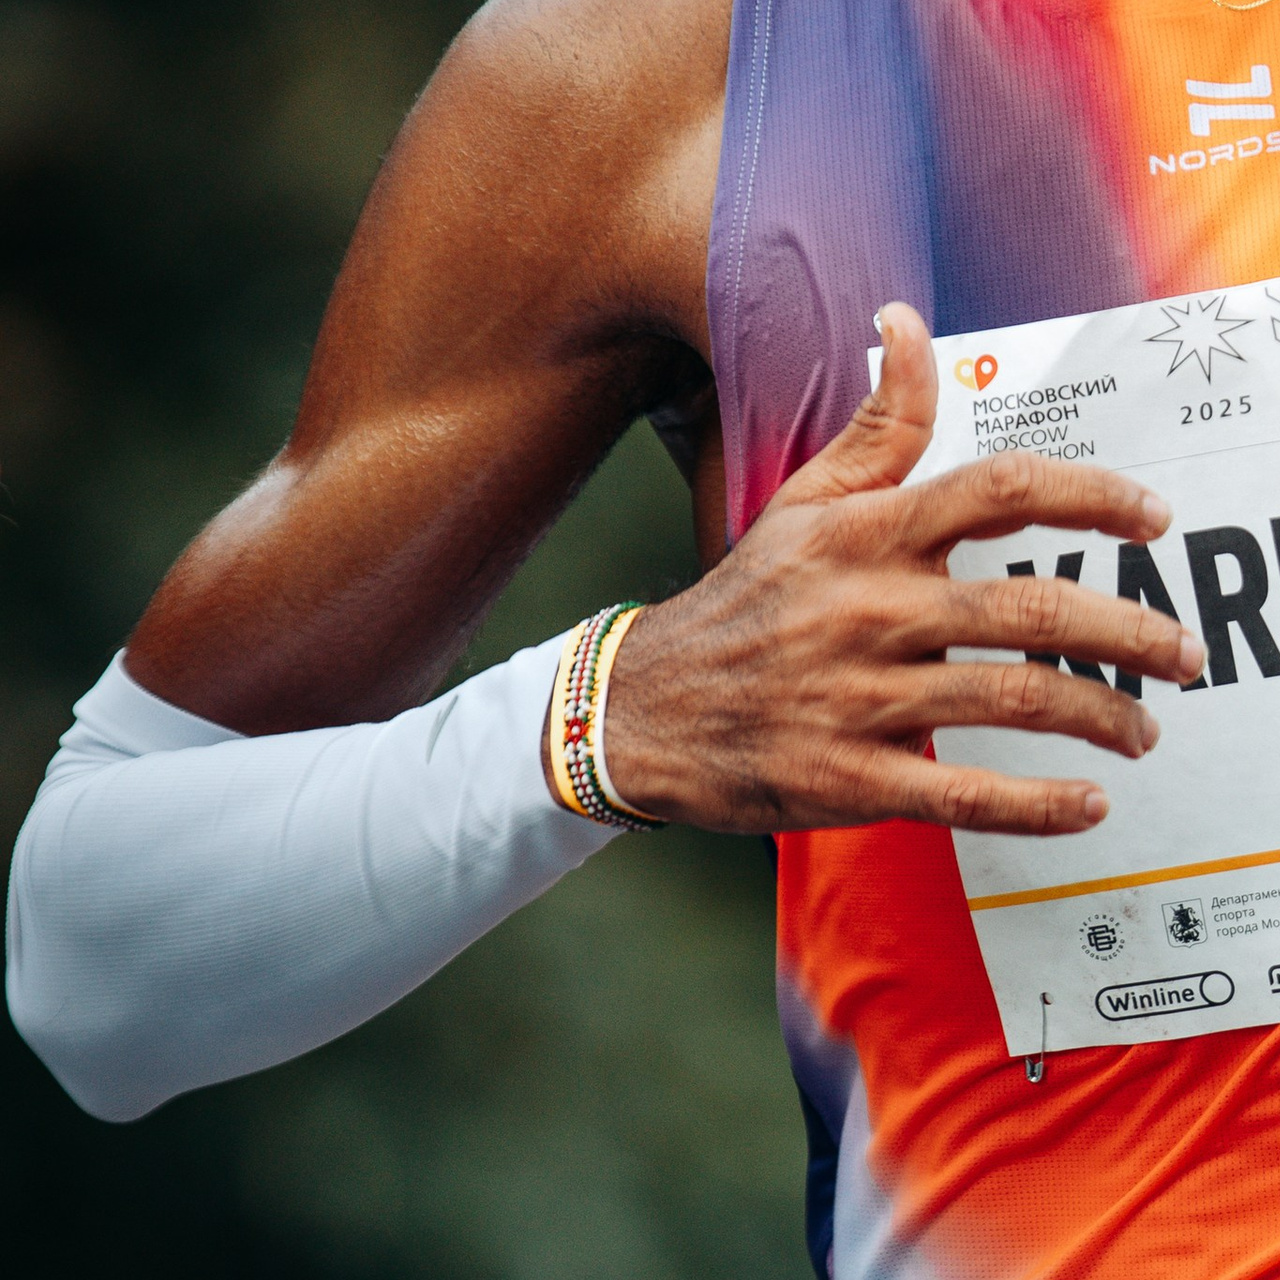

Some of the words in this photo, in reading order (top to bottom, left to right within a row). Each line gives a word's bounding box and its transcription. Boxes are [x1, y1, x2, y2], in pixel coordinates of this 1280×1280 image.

[973, 373, 1118, 416] МОСКОВСКИЙ
[975, 403, 1079, 436] МАРАФОН
[1180, 395, 1253, 425] 2025
[977, 424, 1069, 456] MOSCOW
[1213, 907, 1256, 922] спорта
[1216, 922, 1259, 938] города
[1106, 986, 1195, 1012] Winline
